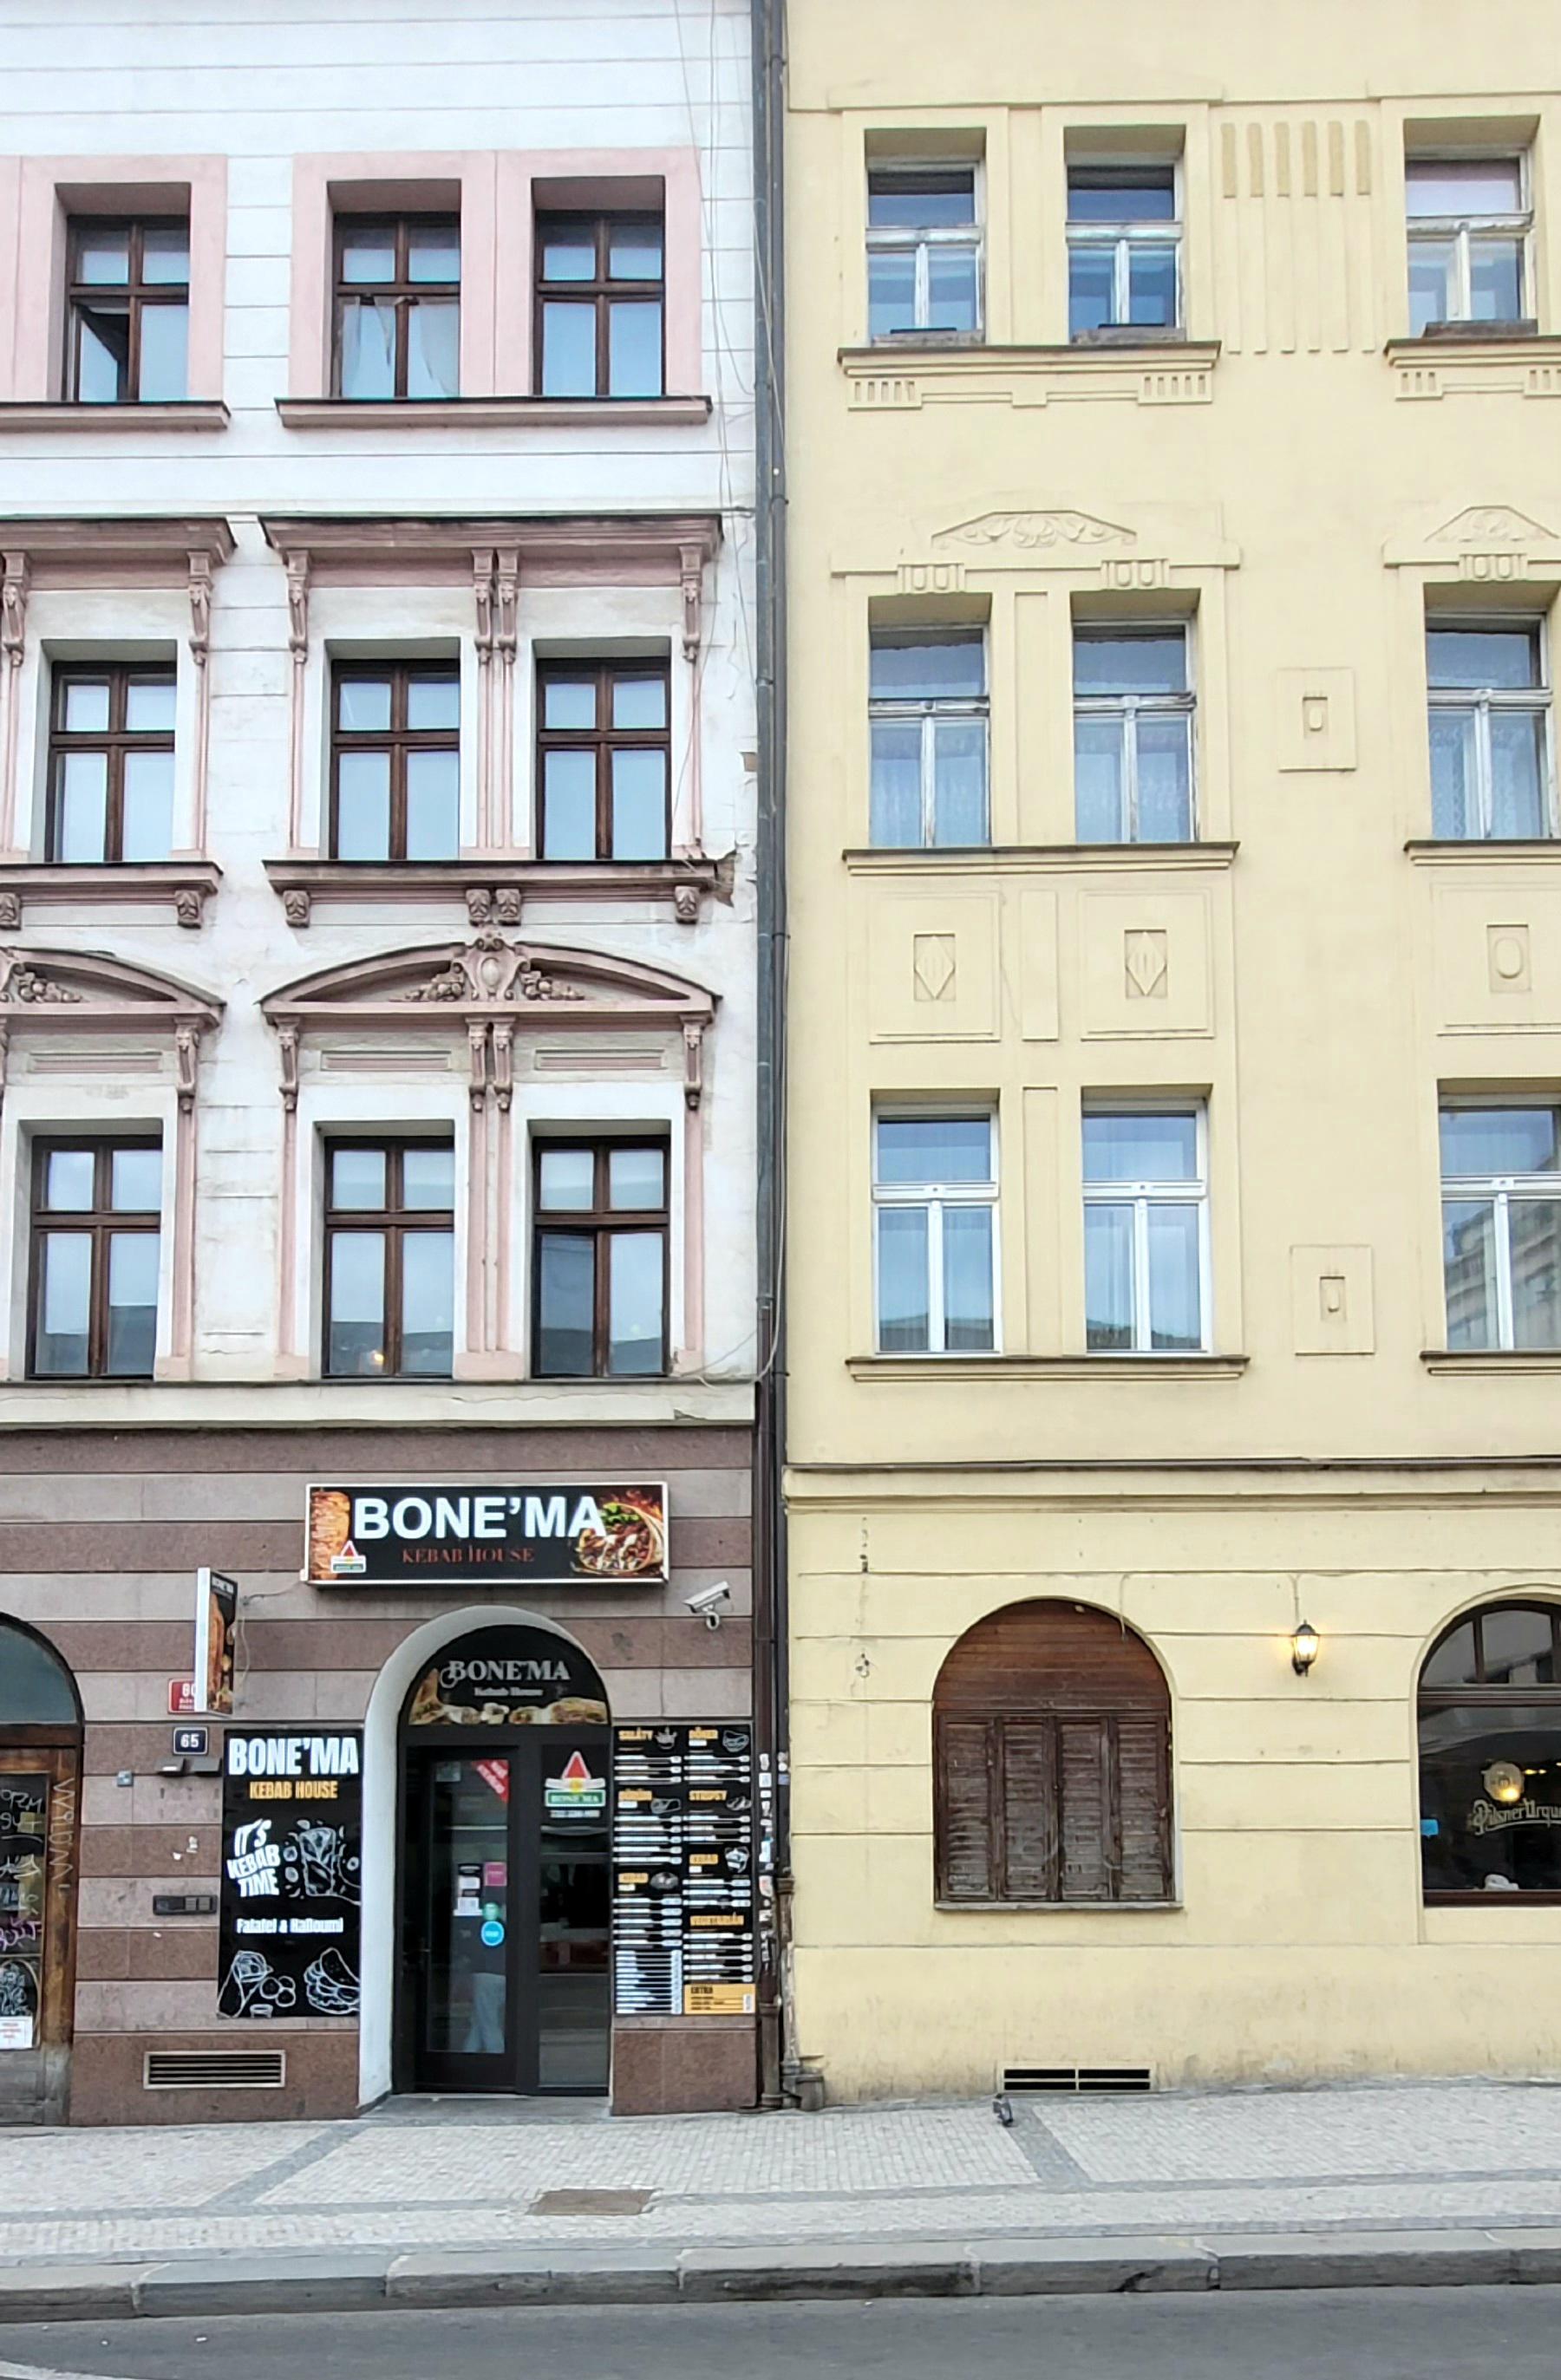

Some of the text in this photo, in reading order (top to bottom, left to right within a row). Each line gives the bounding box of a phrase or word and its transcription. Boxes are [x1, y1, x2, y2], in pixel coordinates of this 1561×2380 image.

[354, 1496, 606, 1539] BONE'MA
[402, 1545, 534, 1563] KEBAB HOUSE
[180, 1733, 199, 1748] 65
[228, 1738, 359, 1775] BONE'MA
[250, 1781, 338, 1799] KEBAB HOUSE
[1473, 1799, 1524, 1836] Pilsner
[234, 1818, 271, 1857] IT'S
[226, 1844, 281, 1879] KEBAB
[238, 1868, 279, 1898] TIME
